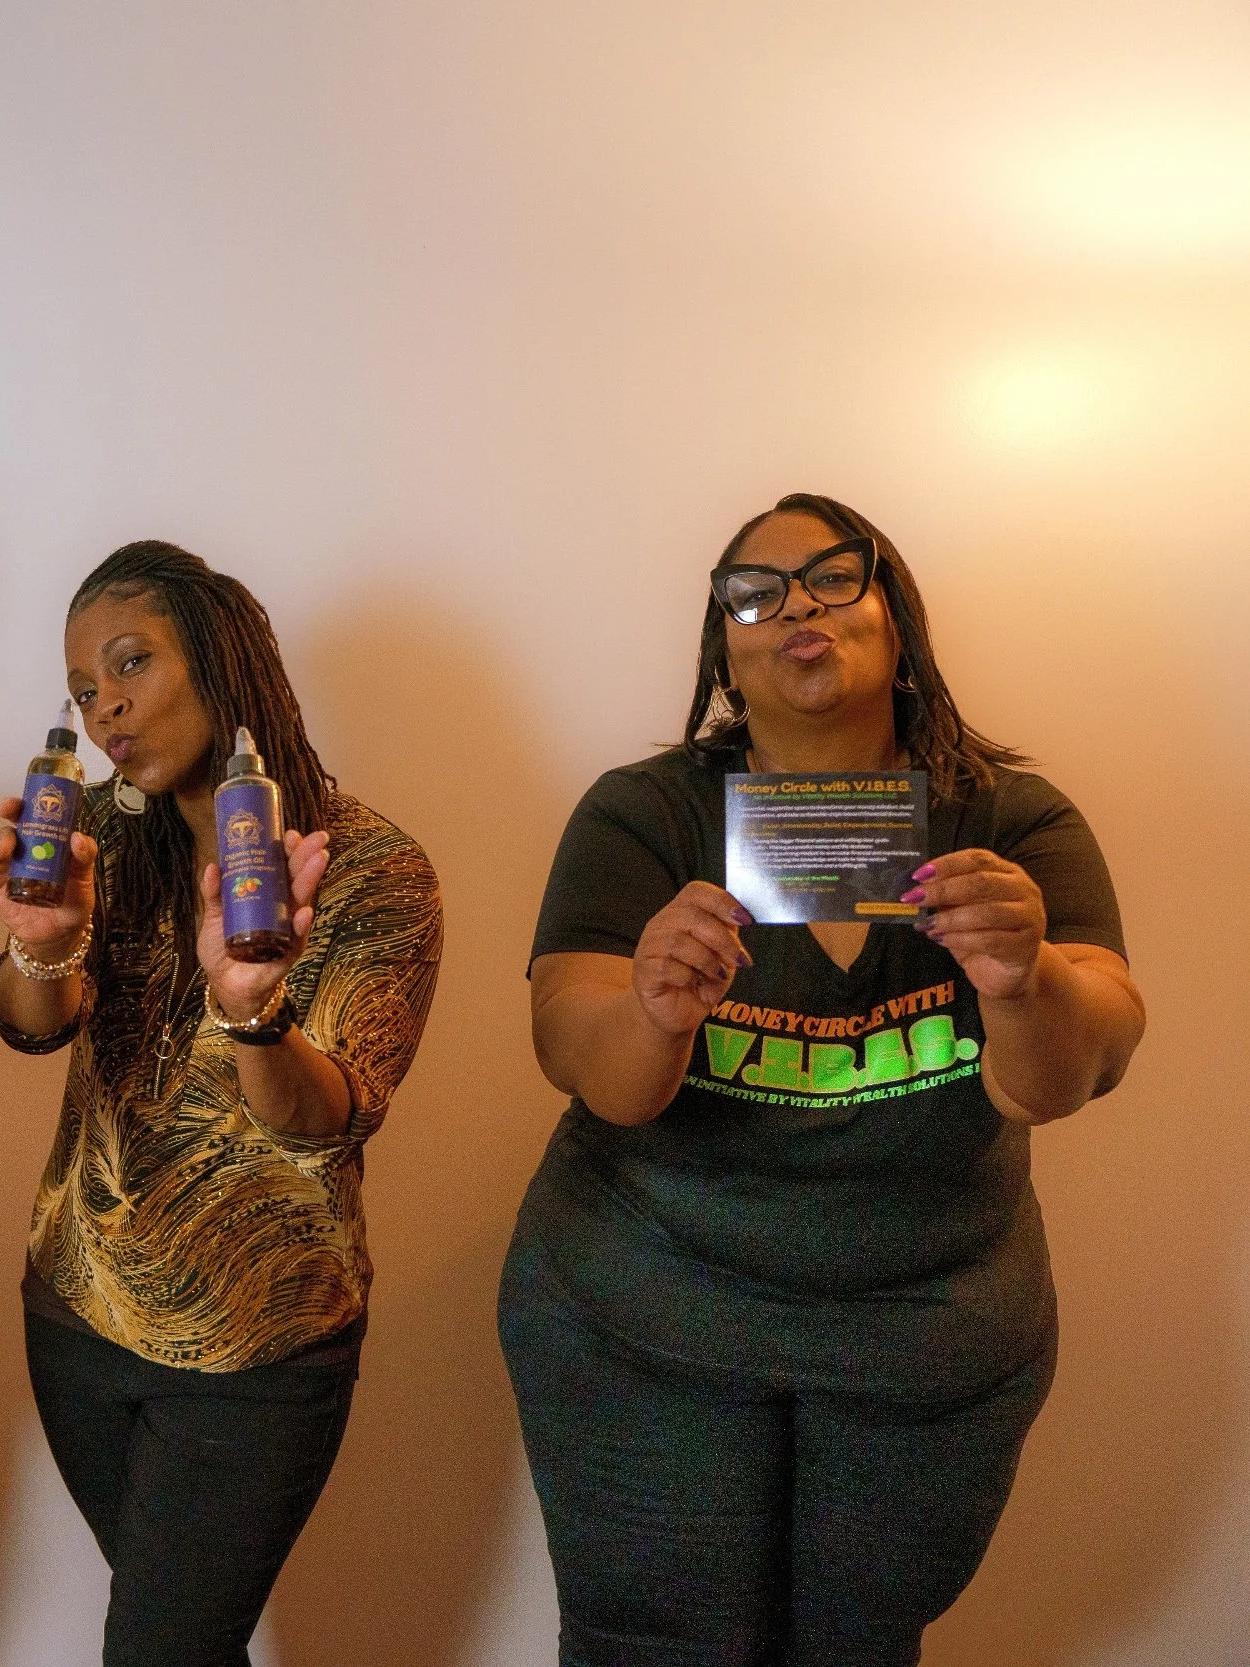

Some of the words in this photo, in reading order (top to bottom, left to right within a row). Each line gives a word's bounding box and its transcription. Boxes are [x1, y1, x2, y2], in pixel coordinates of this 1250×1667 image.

[735, 783, 778, 796] Money
[780, 781, 817, 793] Circle
[821, 780, 850, 792] with
[710, 999, 804, 1033] MONEY
[887, 979, 955, 1017] WITH
[696, 1078, 767, 1102] INITIATIVE
[767, 1093, 790, 1105] BY
[789, 1095, 852, 1108] VITALITY
[853, 1084, 907, 1105] WEALTH
